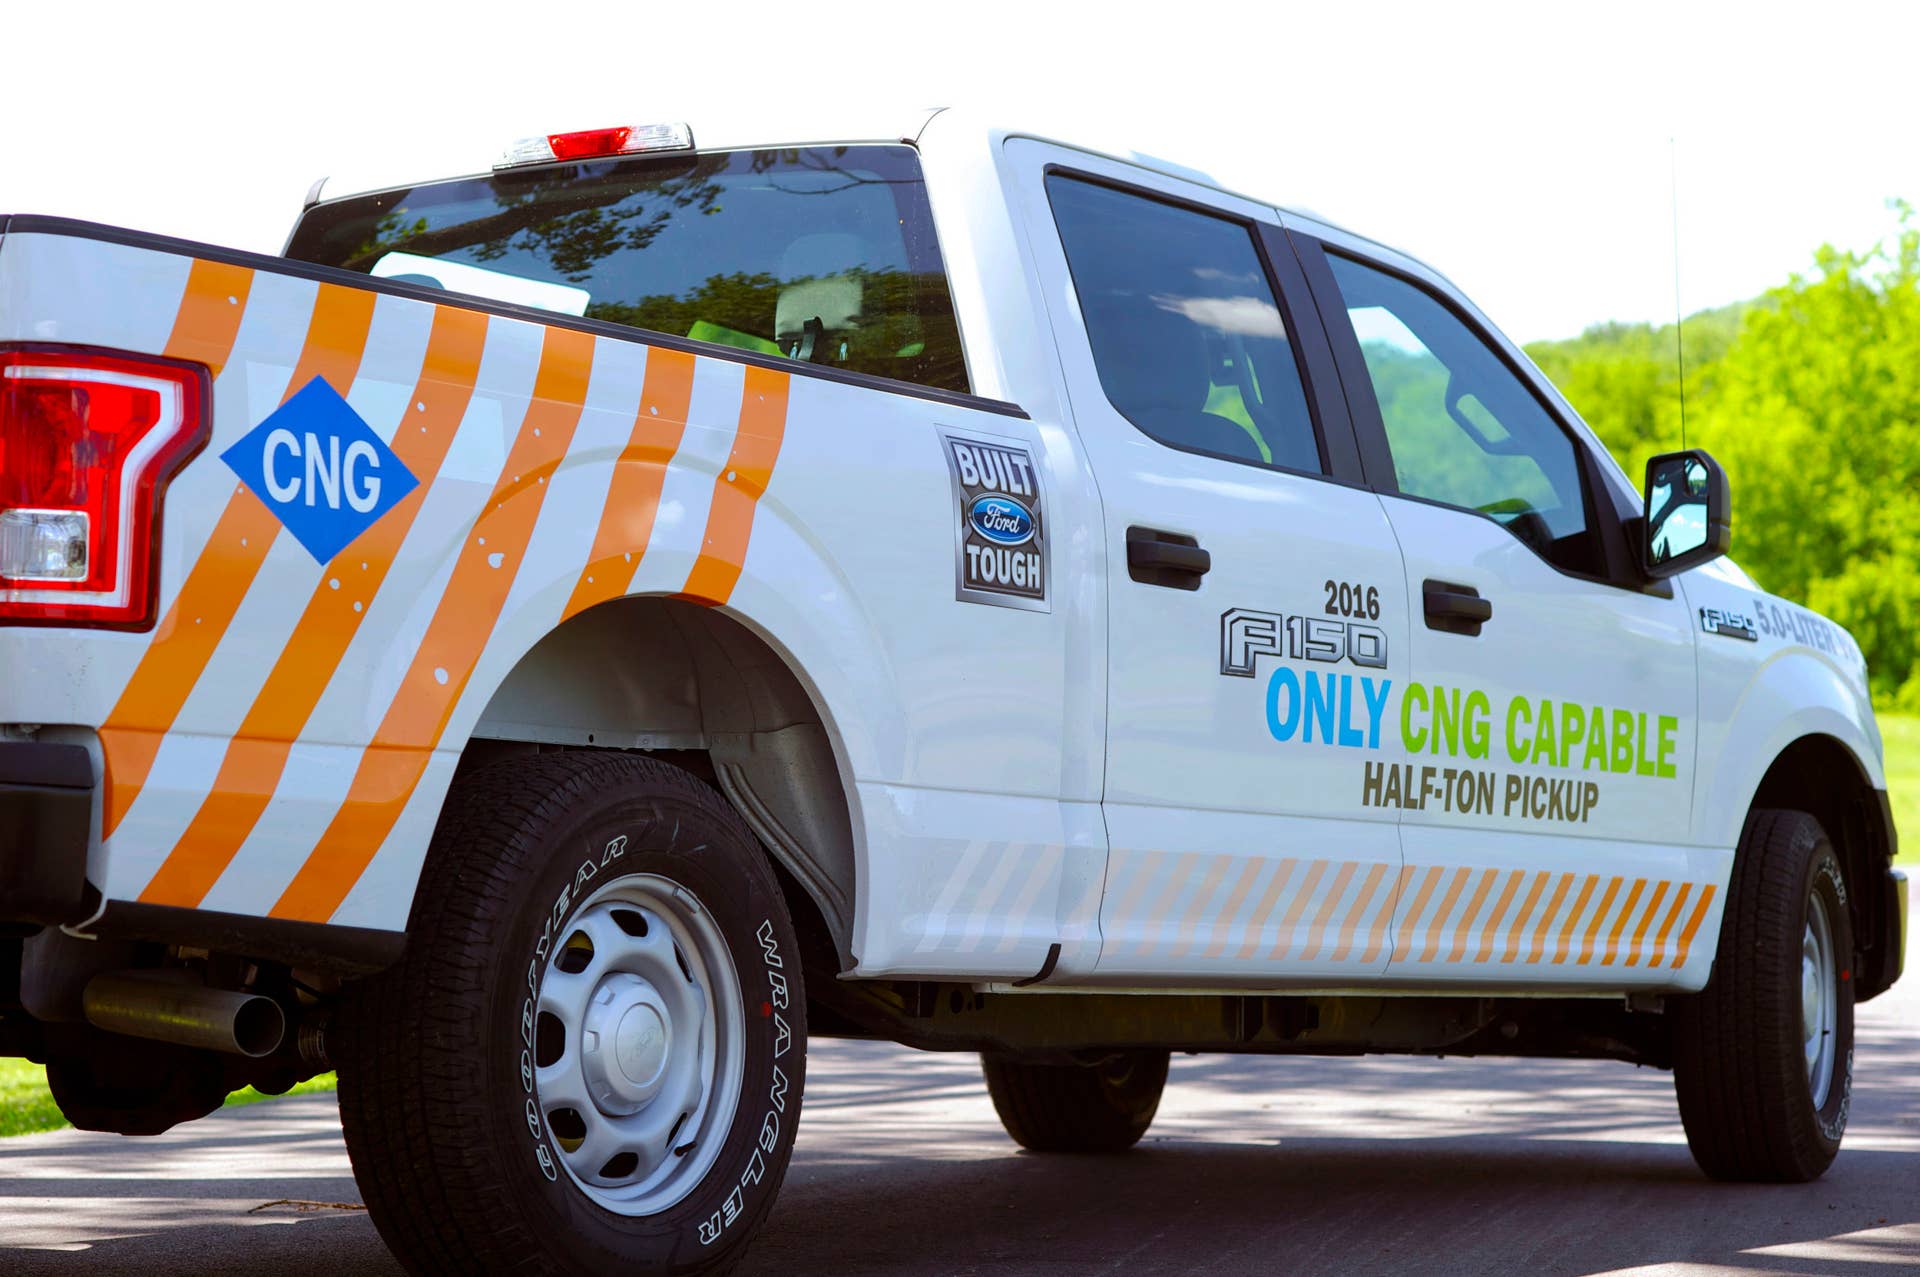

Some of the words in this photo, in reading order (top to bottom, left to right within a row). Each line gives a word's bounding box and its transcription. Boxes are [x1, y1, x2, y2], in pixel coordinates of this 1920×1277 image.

[263, 428, 381, 513] CNG
[953, 443, 1032, 496] BUILT
[983, 503, 1020, 533] Ford
[966, 544, 1040, 589] TOUGH
[1324, 579, 1380, 620] 2016
[1220, 607, 1388, 678] F150
[1266, 666, 1392, 749] ONLY
[1400, 682, 1490, 760] CNG
[1505, 695, 1678, 779] CAPABLE
[1362, 761, 1495, 815] HALF-TON
[1504, 774, 1599, 823] PICKUP
[521, 835, 628, 1182] GOODYEAR
[699, 919, 791, 1246] WRANGLER
